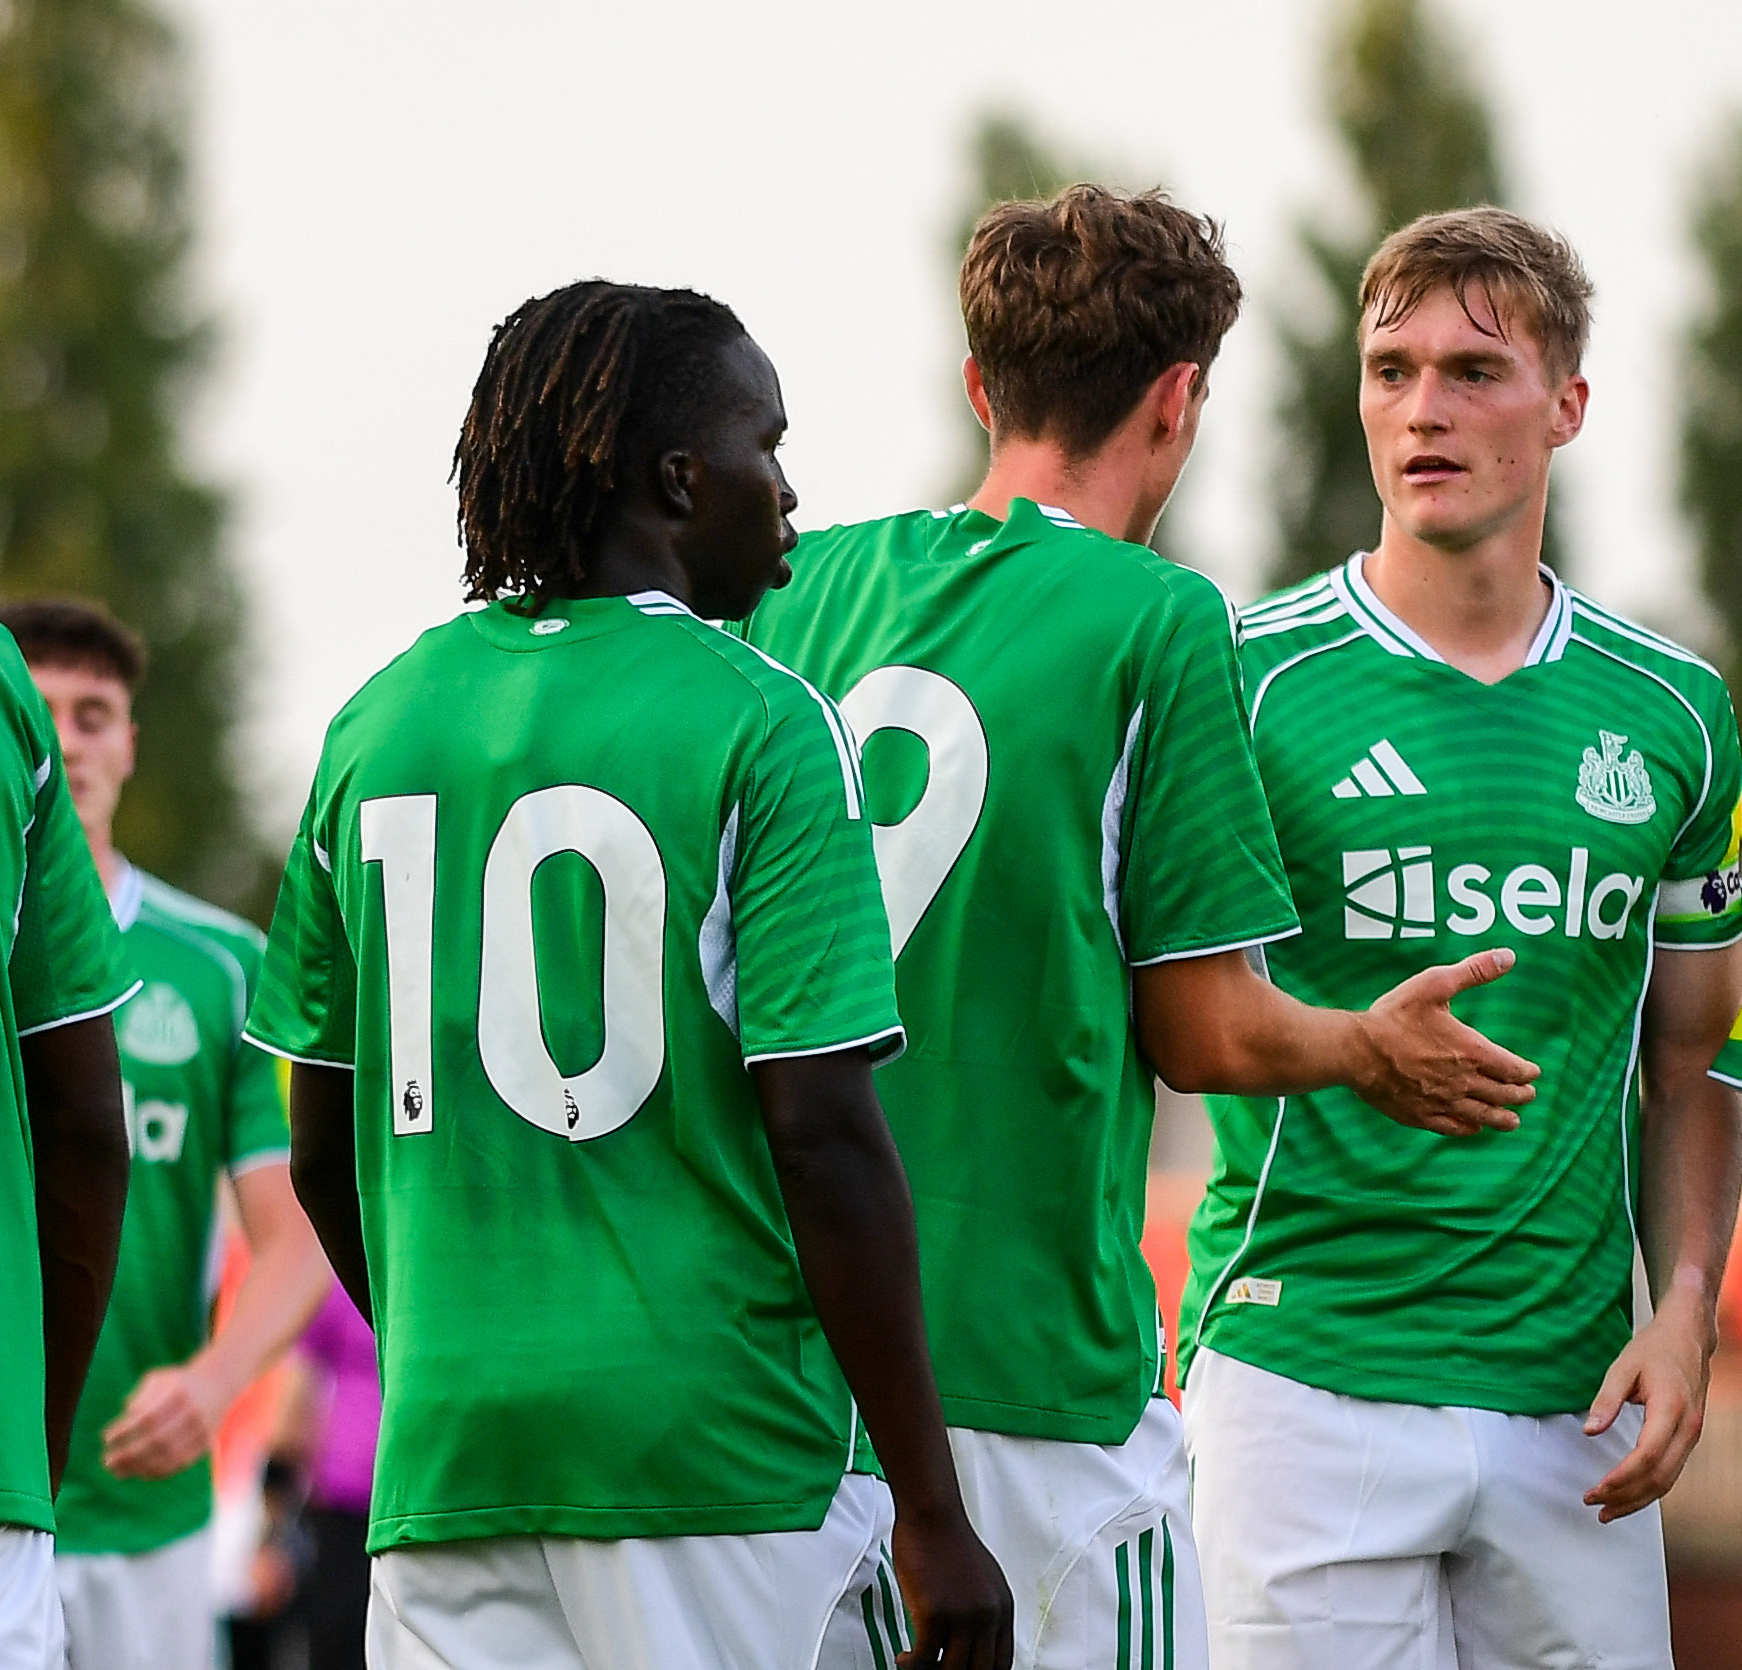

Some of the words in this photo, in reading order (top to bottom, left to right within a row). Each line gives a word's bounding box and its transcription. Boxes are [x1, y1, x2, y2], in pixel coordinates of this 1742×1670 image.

[360, 784, 666, 1142] 10
[839, 665, 990, 963] 9
[1446, 847, 1645, 940] sela
